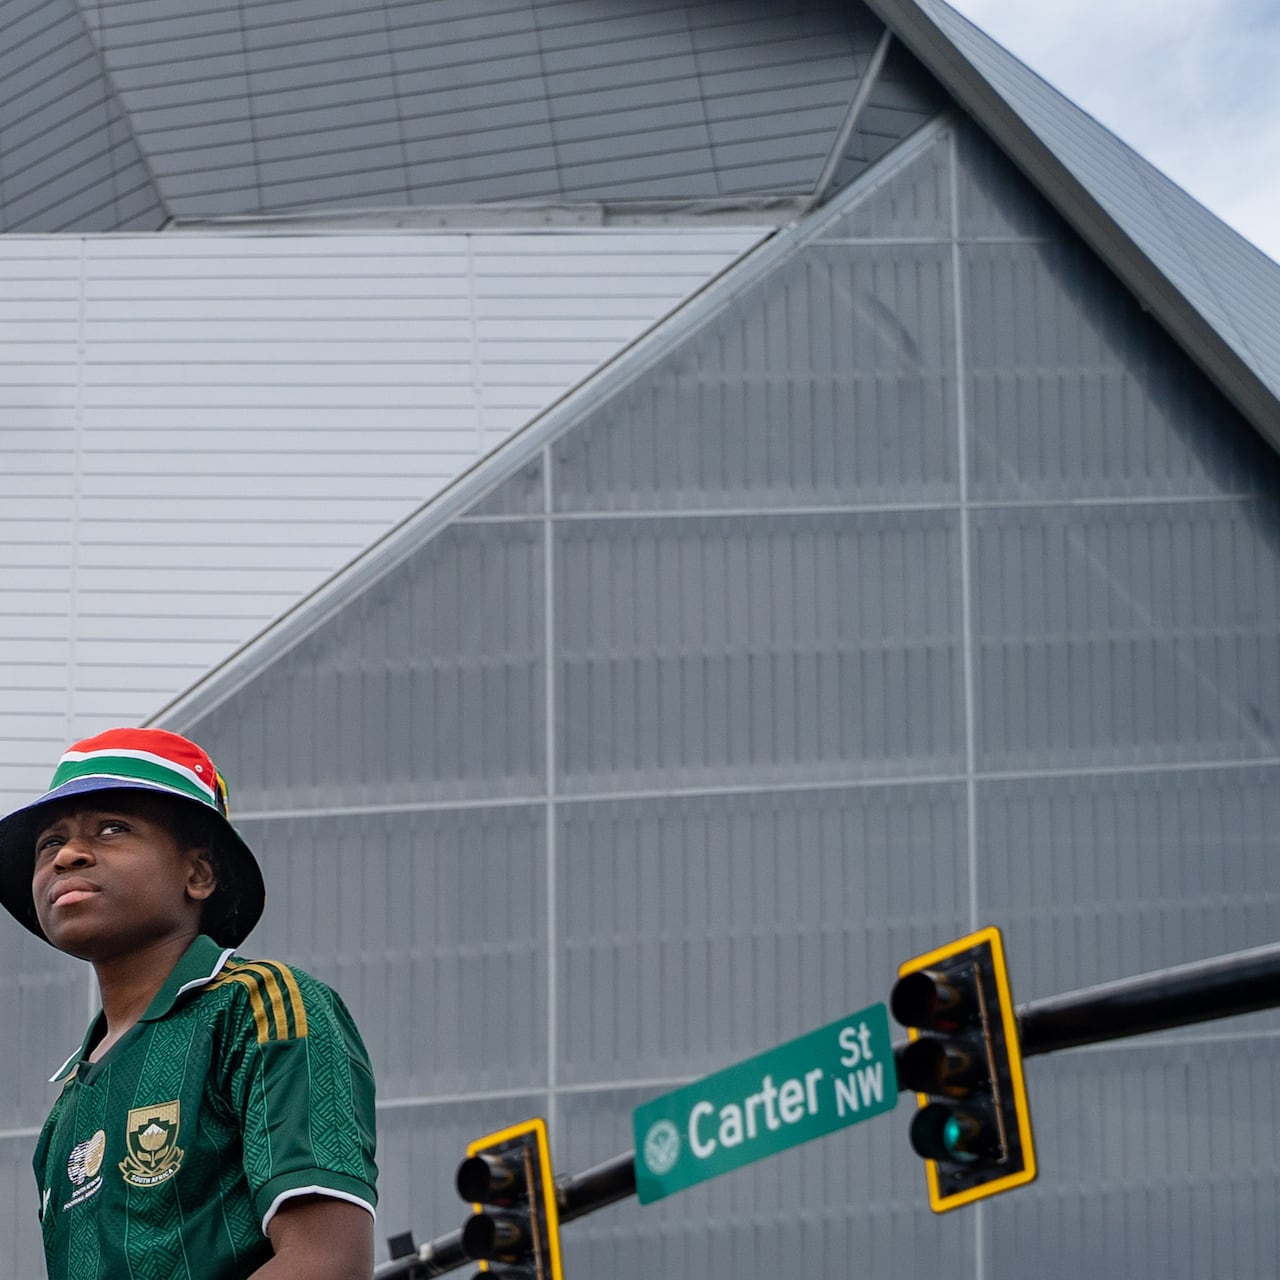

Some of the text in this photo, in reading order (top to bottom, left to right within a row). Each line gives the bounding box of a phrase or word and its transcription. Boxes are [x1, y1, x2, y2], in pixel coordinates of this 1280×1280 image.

[837, 1021, 874, 1068] St
[688, 1067, 824, 1159] Carter
[833, 1061, 884, 1128] NW
[130, 1168, 175, 1185] SOUTH AFRICA
